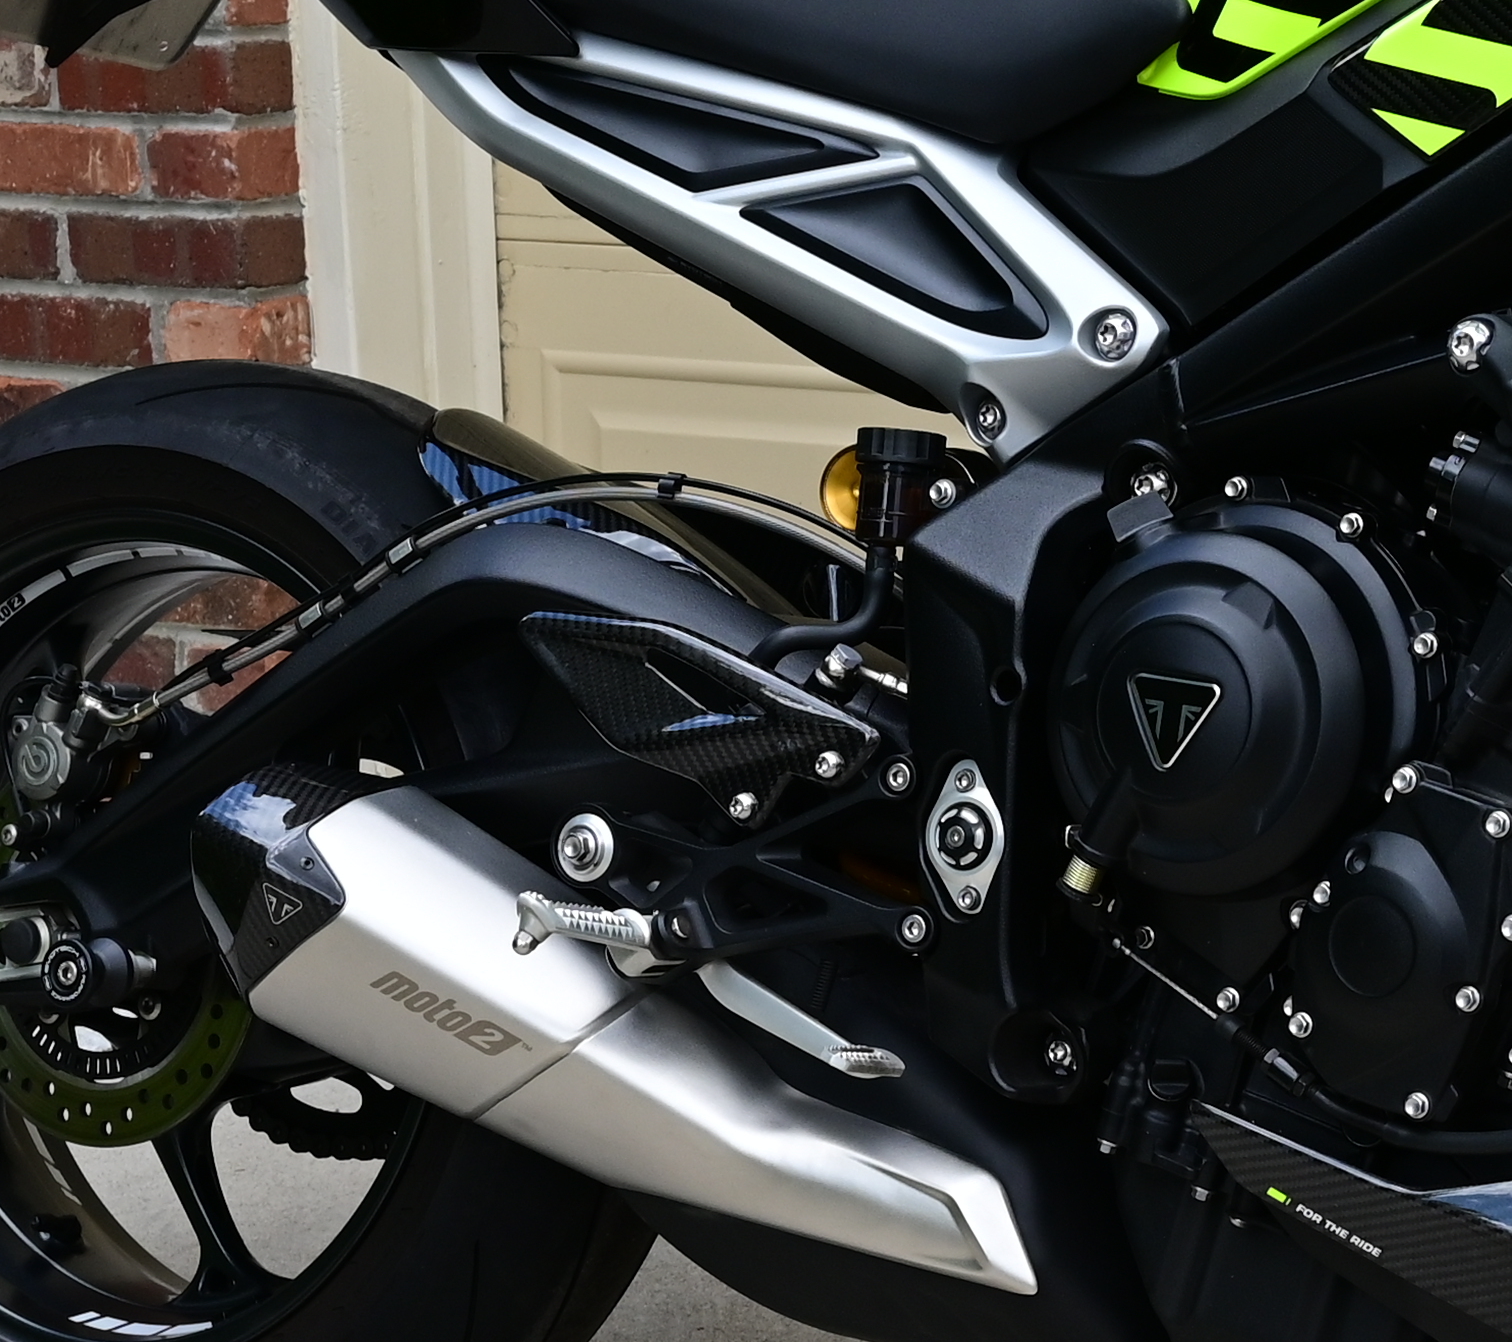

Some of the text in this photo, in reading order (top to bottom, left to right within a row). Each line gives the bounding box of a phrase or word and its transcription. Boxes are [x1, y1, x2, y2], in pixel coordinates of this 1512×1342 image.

[369, 970, 523, 1056] moto2
[1295, 1203, 1382, 1258] FOR THE RIDE
